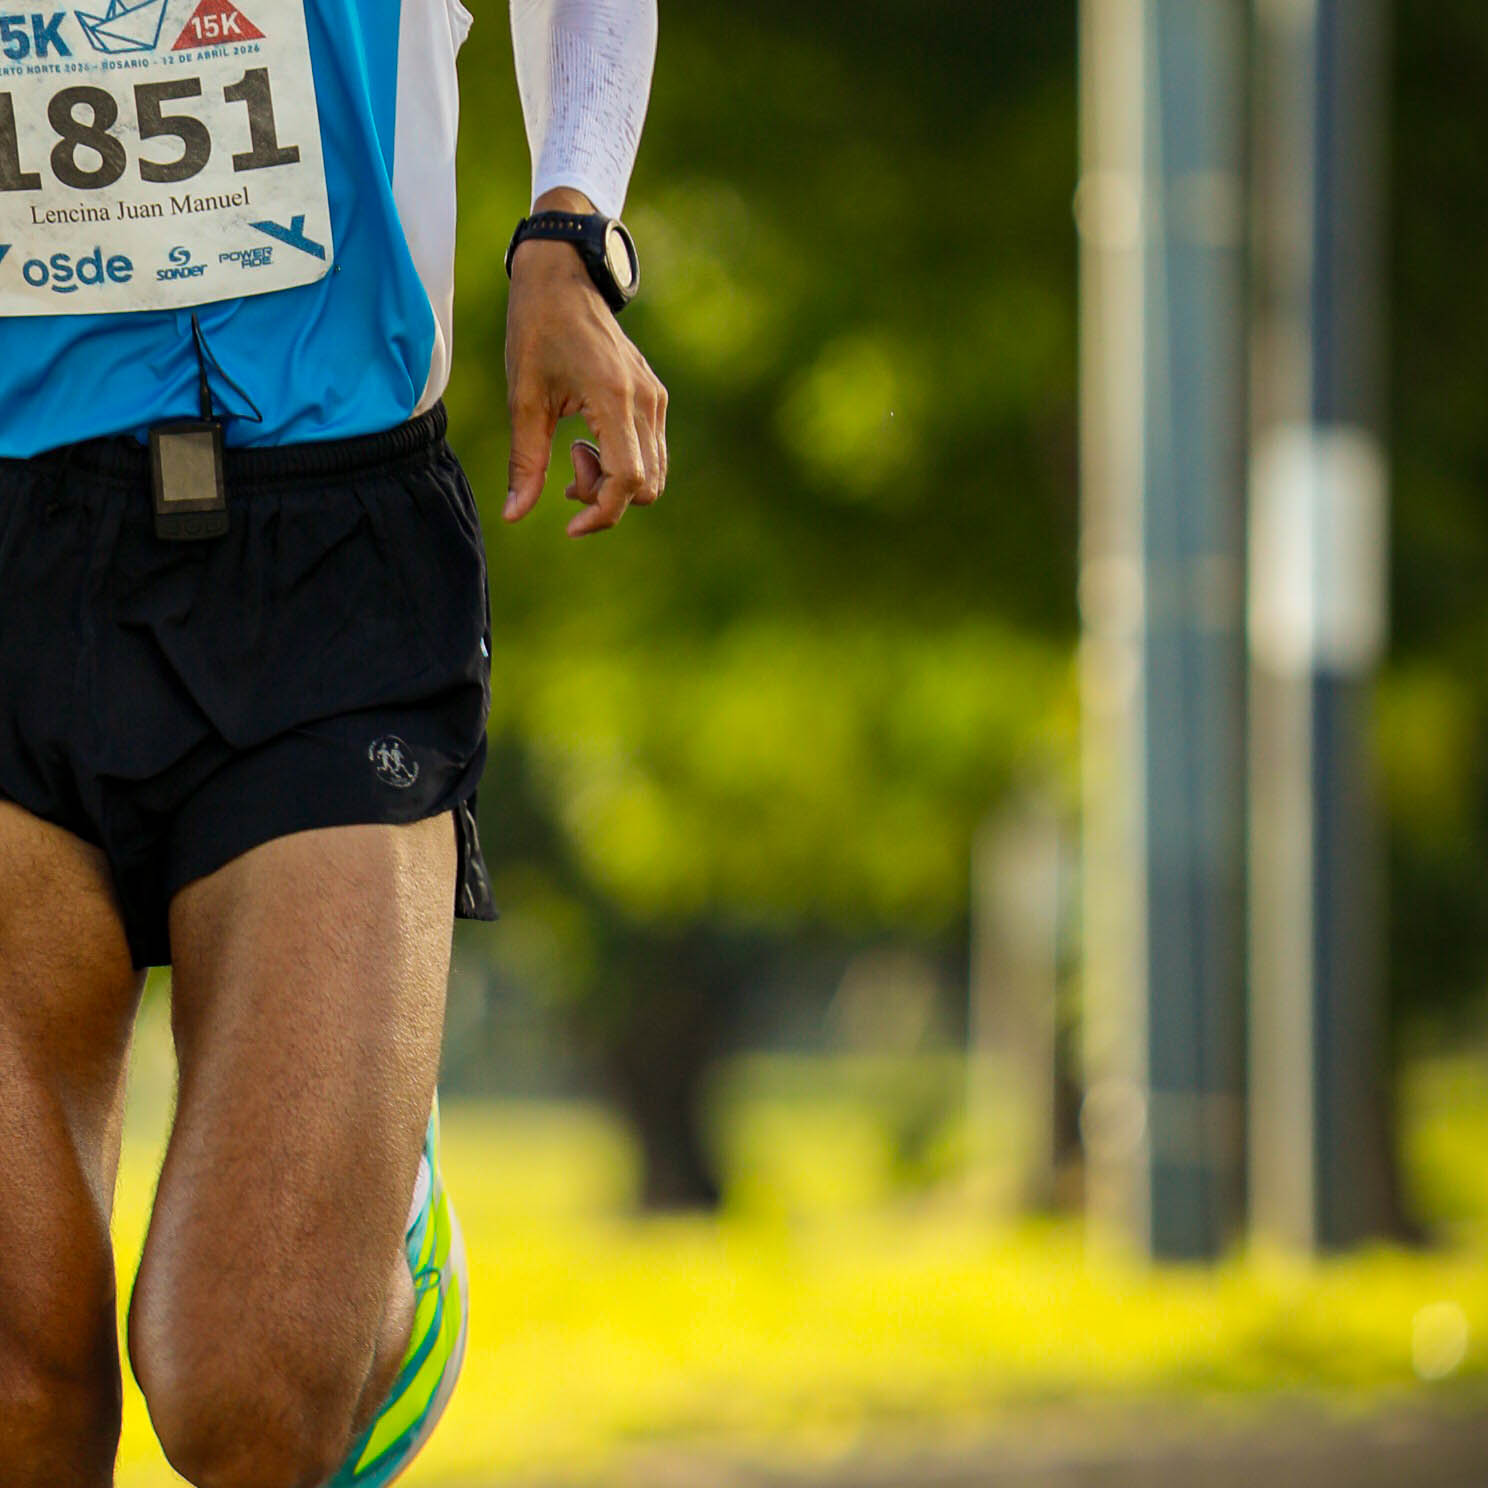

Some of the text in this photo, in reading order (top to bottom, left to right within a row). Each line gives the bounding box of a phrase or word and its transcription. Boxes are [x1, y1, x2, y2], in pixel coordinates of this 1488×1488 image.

[191, 11, 241, 40] 15K
[27, 64, 61, 74] NORTE
[102, 58, 149, 71] ROSARIO
[162, 56, 175, 66] 12
[178, 53, 193, 63] DE
[197, 48, 230, 61] ABRIL
[233, 45, 261, 56] 2026
[30, 186, 251, 225] Lencina Juan Manuel
[22, 245, 134, 288] osde
